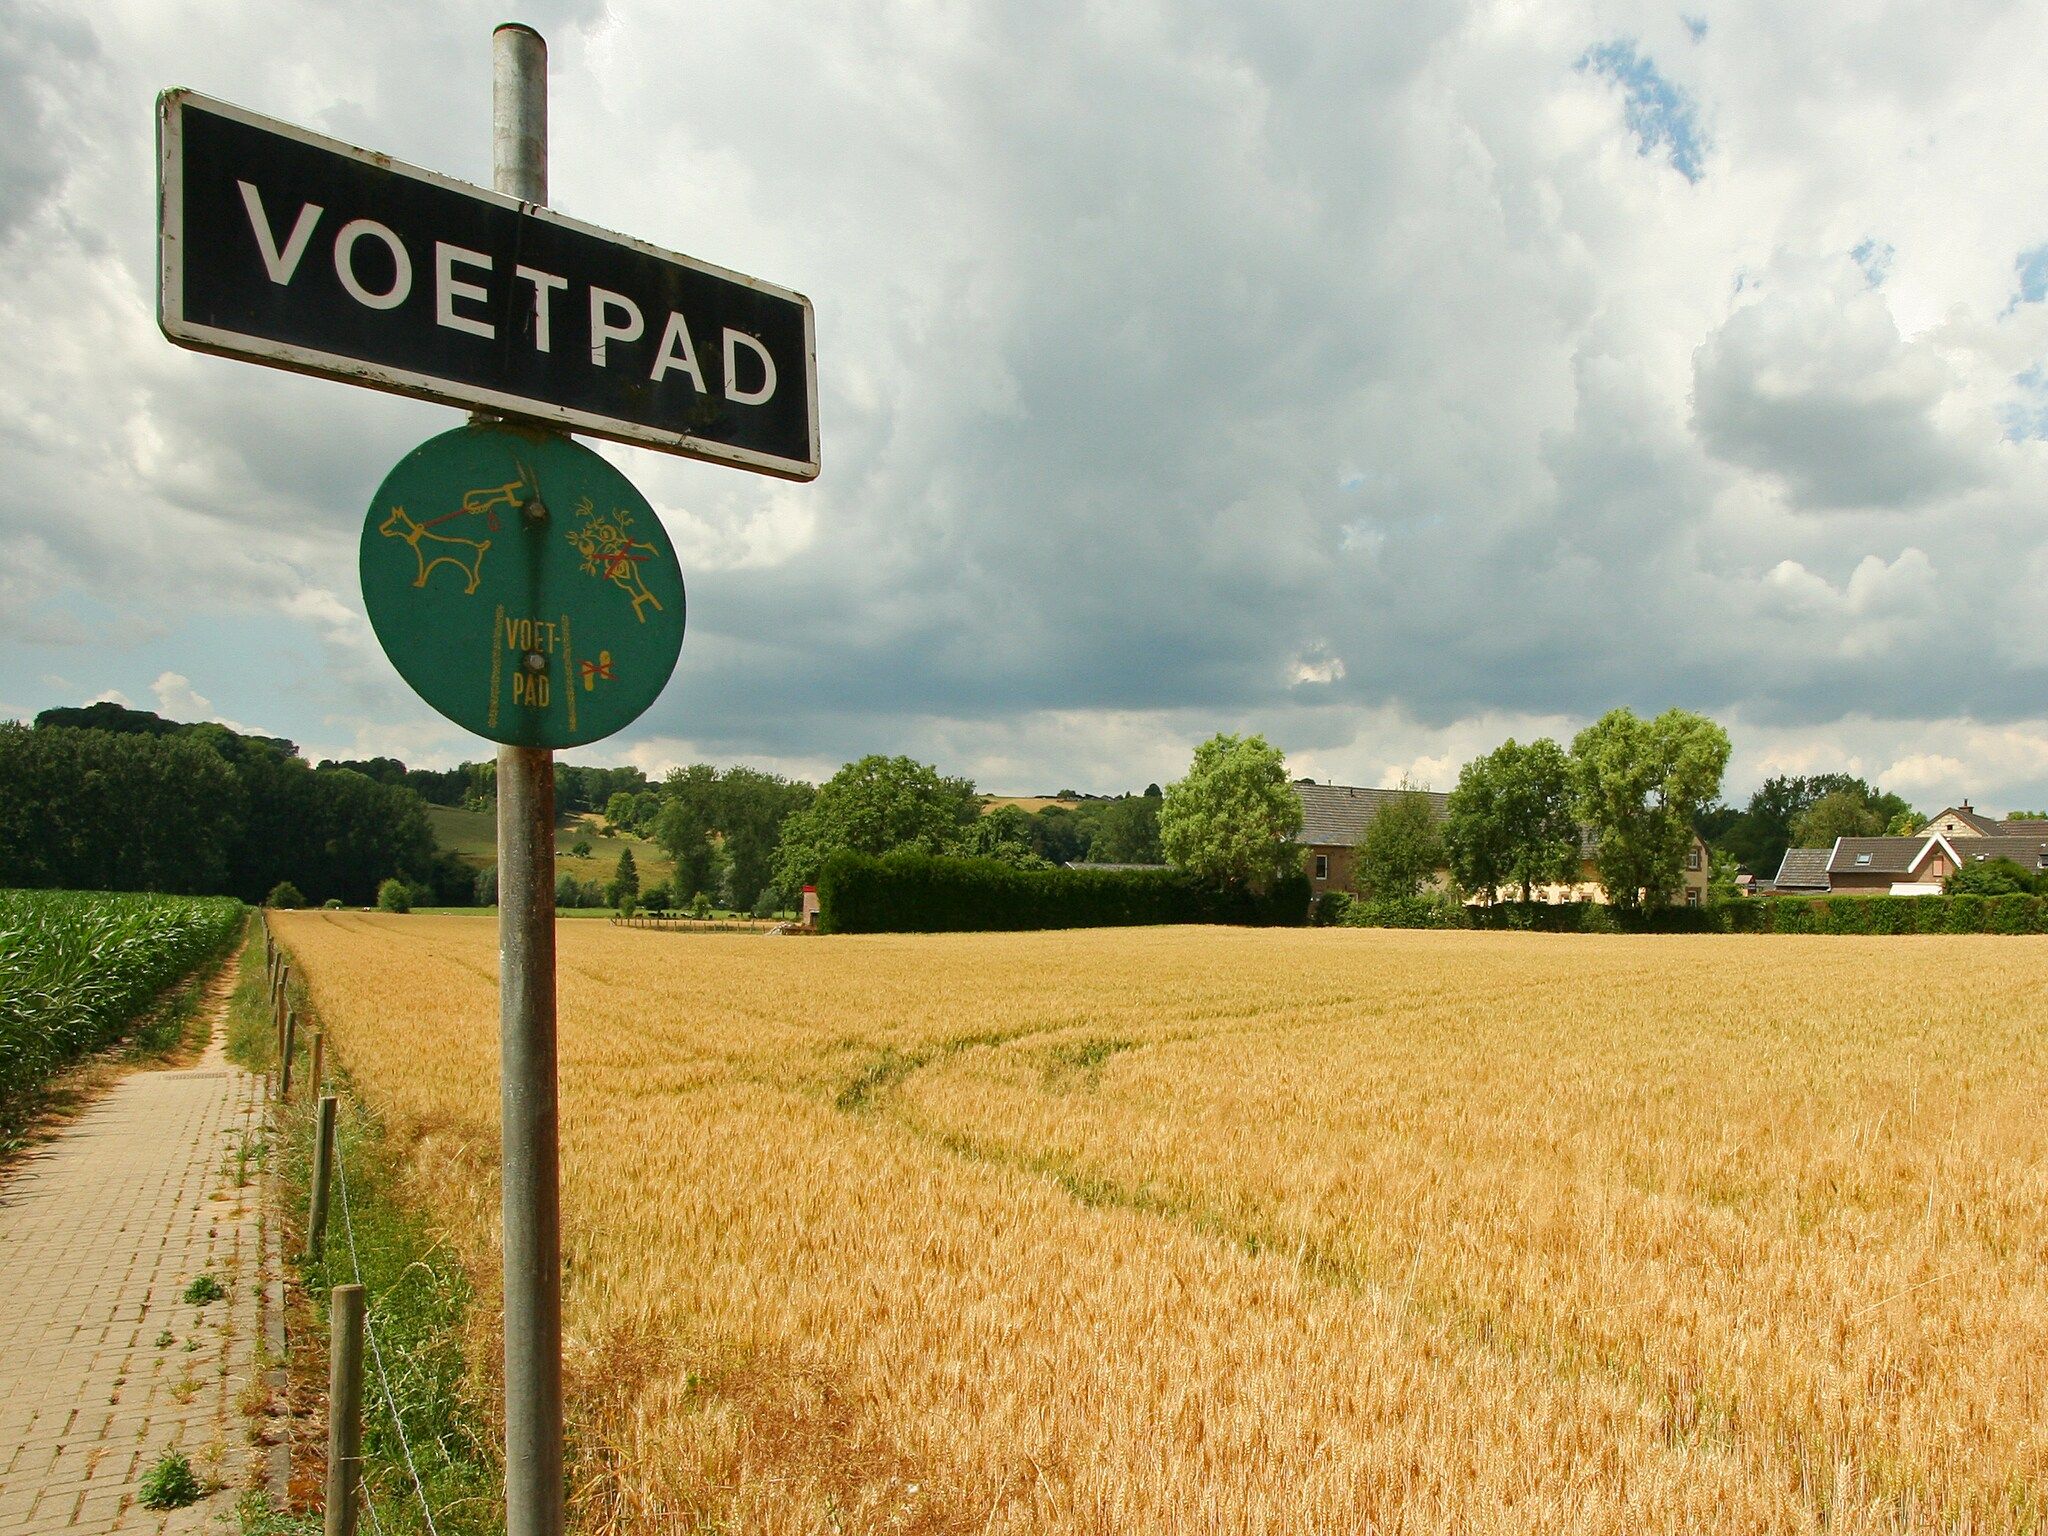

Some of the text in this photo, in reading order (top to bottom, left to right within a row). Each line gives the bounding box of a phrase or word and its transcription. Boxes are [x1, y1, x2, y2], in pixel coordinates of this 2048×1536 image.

[236, 179, 779, 406] VOETPAD
[506, 617, 560, 654] VOET-
[513, 673, 550, 707] PAD
